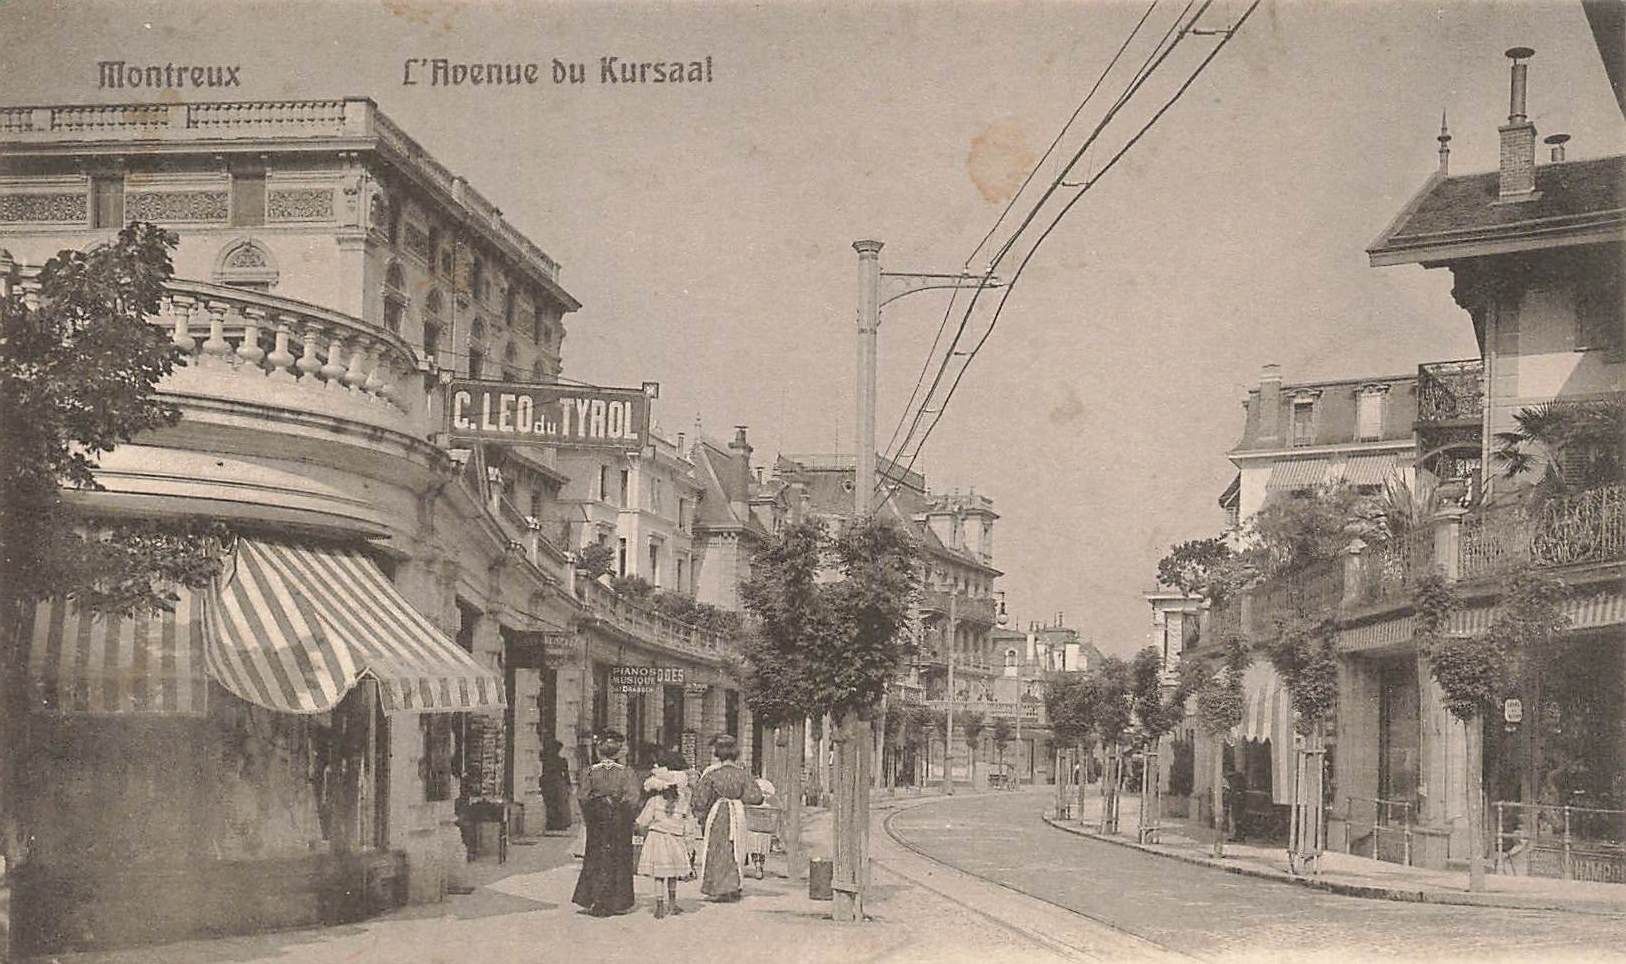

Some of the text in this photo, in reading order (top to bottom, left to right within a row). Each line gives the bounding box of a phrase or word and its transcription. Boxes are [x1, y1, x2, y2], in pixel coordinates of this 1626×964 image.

[454, 391, 638, 440] C. LEO du TYROL
[612, 667, 656, 676] PIANOS
[656, 668, 684, 682] ODES
